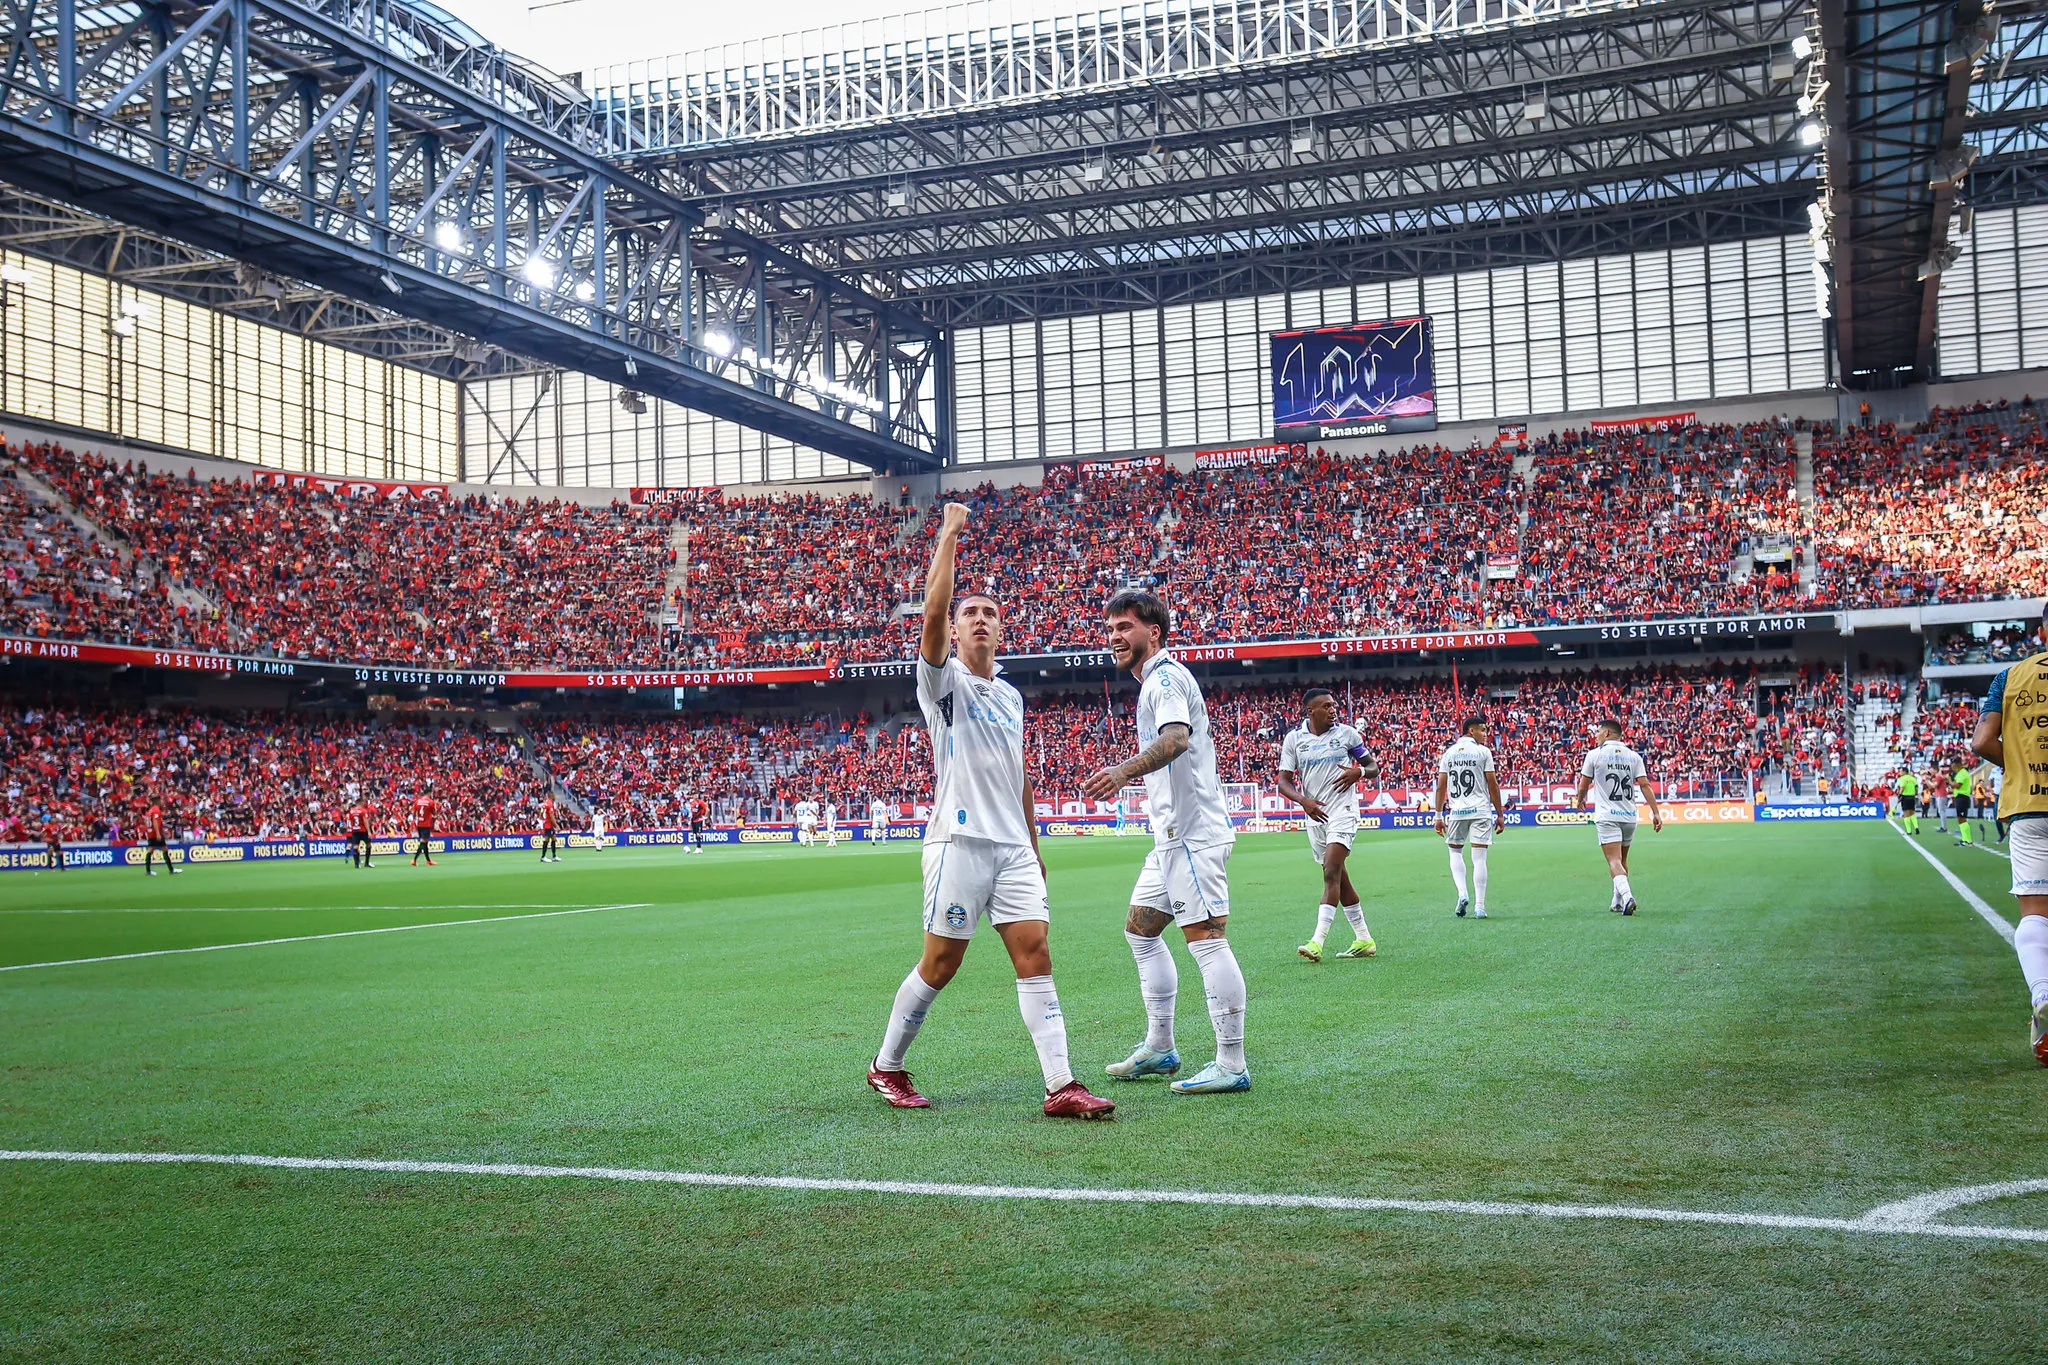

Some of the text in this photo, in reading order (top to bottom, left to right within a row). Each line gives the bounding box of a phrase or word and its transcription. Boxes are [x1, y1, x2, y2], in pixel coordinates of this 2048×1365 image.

[1320, 423, 1387, 438] Panasonic
[1630, 626, 1647, 638] SE
[1656, 623, 1708, 636] VESTE
[1717, 621, 1749, 633] POR
[1758, 618, 1806, 631] AMOR
[4, 640, 79, 658] POR AMOR
[1347, 640, 1363, 652] SE
[1371, 638, 1418, 650] VESTE
[1426, 636, 1455, 648] POR
[1464, 633, 1506, 646] AMOR
[1088, 654, 1104, 666] SE
[1170, 648, 1235, 661] OR AMOR
[176, 655, 190, 667] SE
[195, 656, 232, 671] VESTE
[237, 659, 259, 673] POR
[264, 663, 294, 676] AMOR
[851, 667, 865, 677] SE
[871, 665, 911, 676] VESTE
[374, 671, 388, 682] SE
[394, 671, 431, 683] VESTE
[438, 673, 463, 685] POR
[470, 674, 506, 685] AMOR
[611, 675, 627, 686] SE
[634, 674, 677, 685] VESTE
[684, 673, 710, 684] POR
[717, 672, 754, 683] AMOR
[1449, 769, 1475, 798] 39
[1605, 772, 1633, 801] 26
[1394, 814, 1414, 826] FIOS
[1416, 813, 1423, 826] E
[1536, 811, 1597, 824] cobreco
[1684, 807, 1713, 820] GOL
[1719, 807, 1748, 820] GOL
[1760, 805, 1878, 820] Esportes da Sorte
[629, 834, 648, 844] FIOS
[649, 834, 654, 844] E
[656, 832, 683, 844] CABOS
[890, 827, 920, 838] CABOS
[254, 841, 346, 857] FIOS E CABOS ELÉTRICOS
[452, 839, 466, 849] FIOS
[471, 837, 492, 849] CABOS
[495, 836, 524, 849] ELÉTRICOS
[63, 849, 113, 866] ELÉTRICOS
